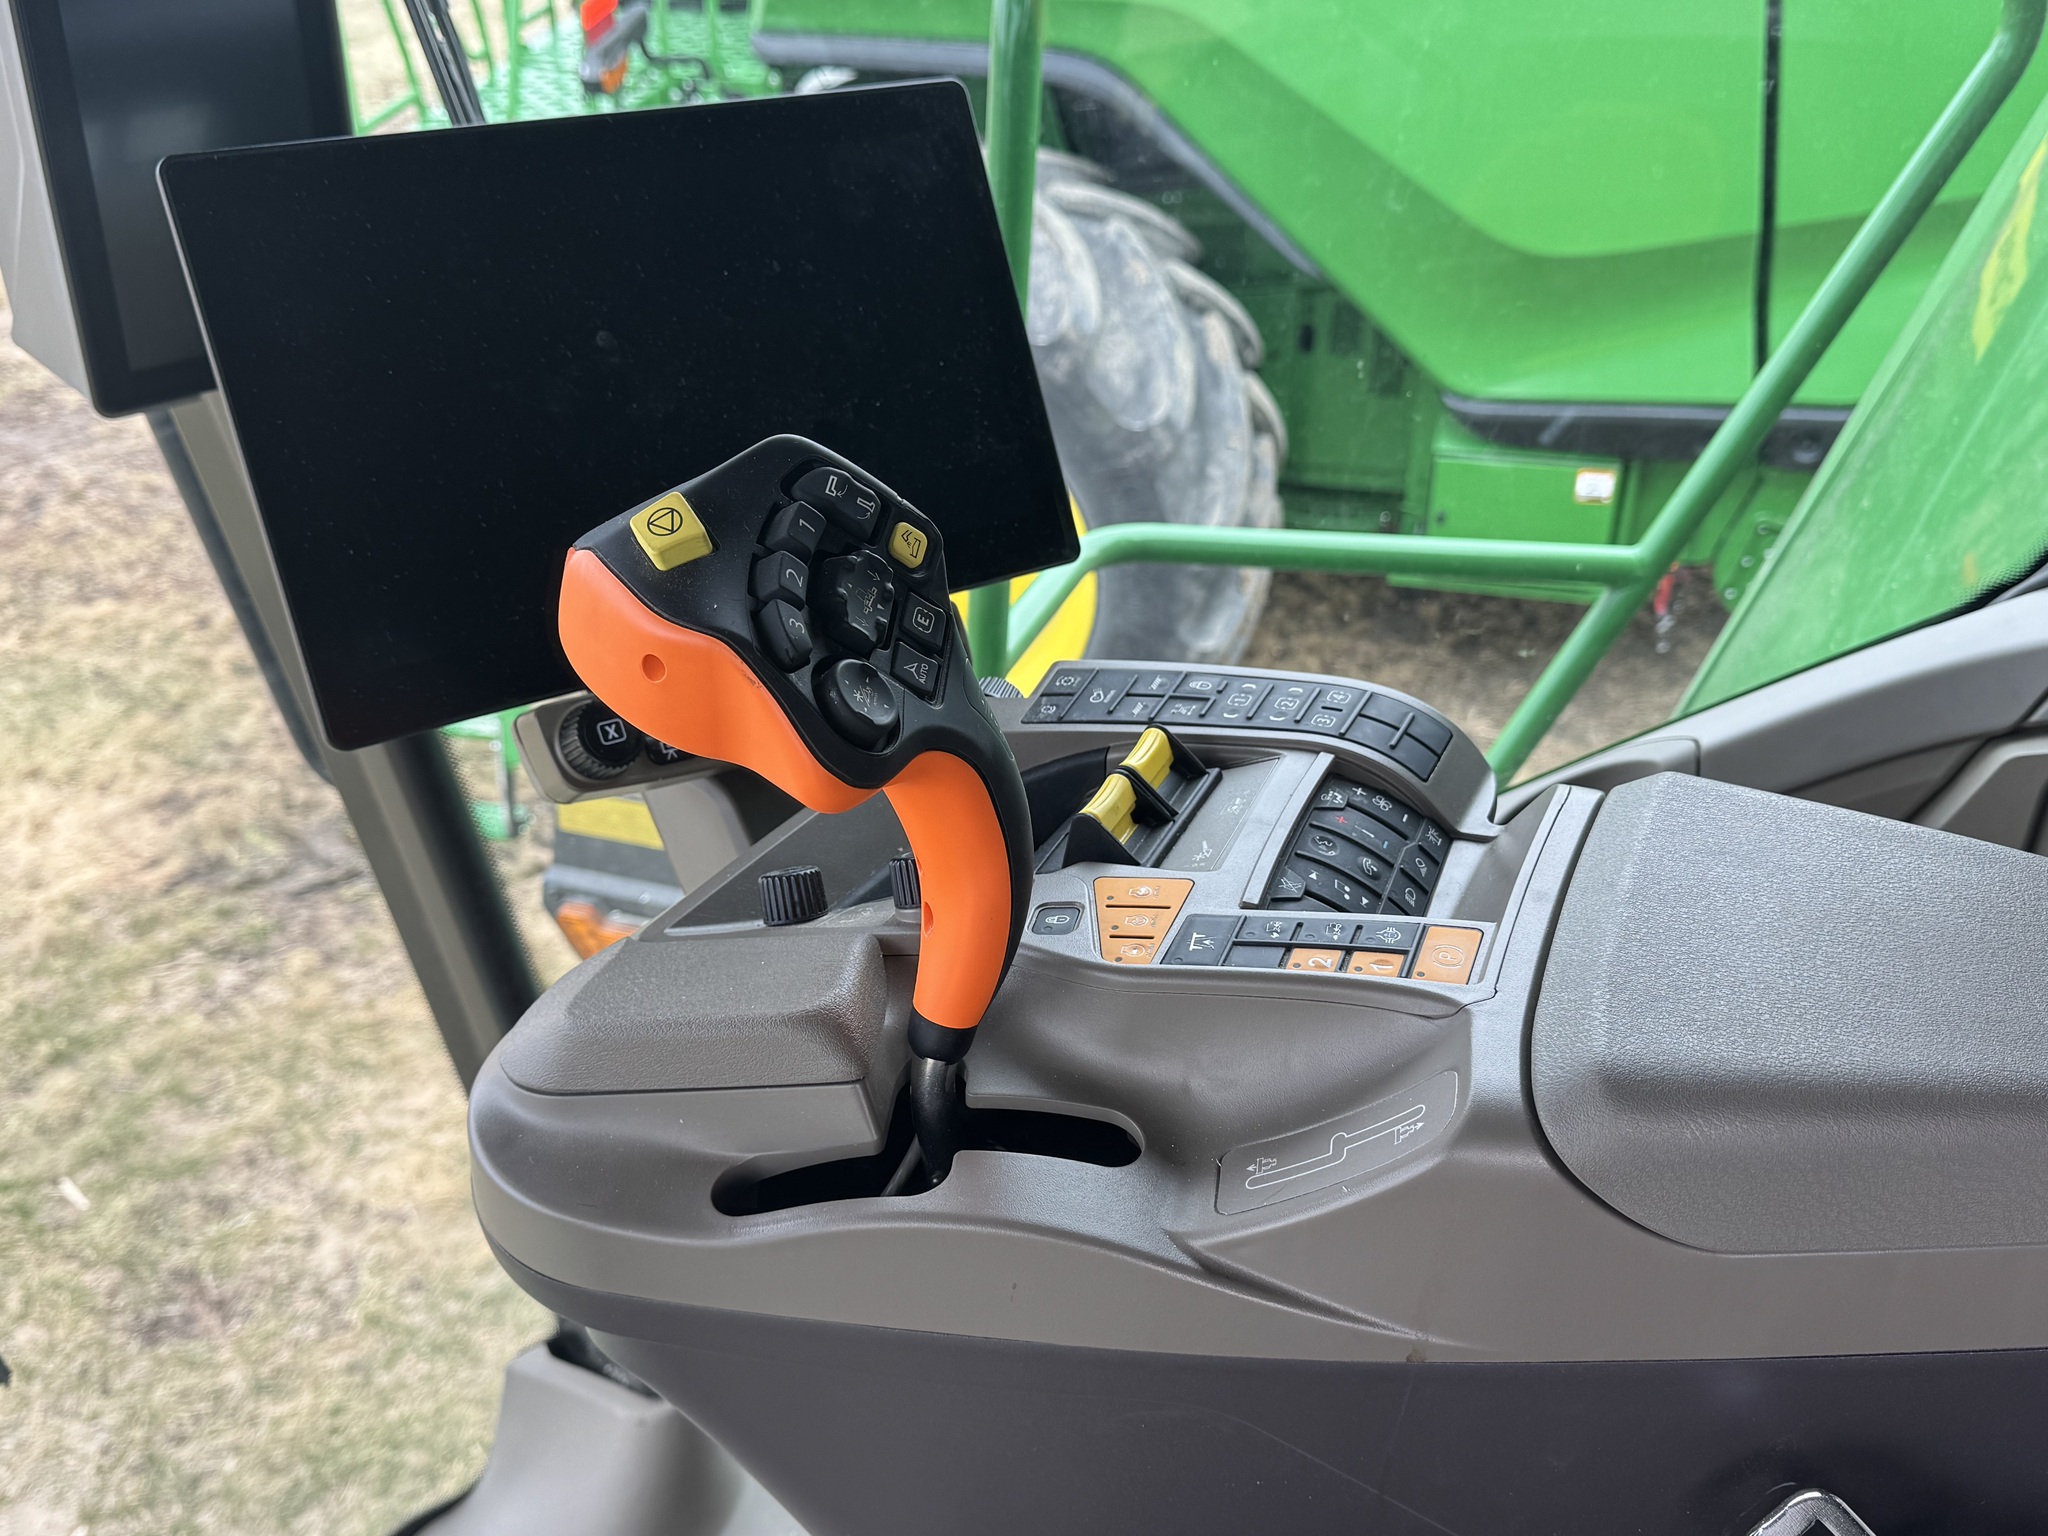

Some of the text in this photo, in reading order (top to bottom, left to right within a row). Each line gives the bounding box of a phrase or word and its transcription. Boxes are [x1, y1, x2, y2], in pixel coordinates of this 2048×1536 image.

[799, 518, 815, 534] 1
[785, 568, 803, 587] 2
[790, 618, 805, 633] 3
[919, 663, 929, 684] AUTO
[604, 724, 620, 740] X
[1308, 957, 1331, 969] 2
[1438, 951, 1457, 960] P
[1369, 961, 1393, 971] 1
